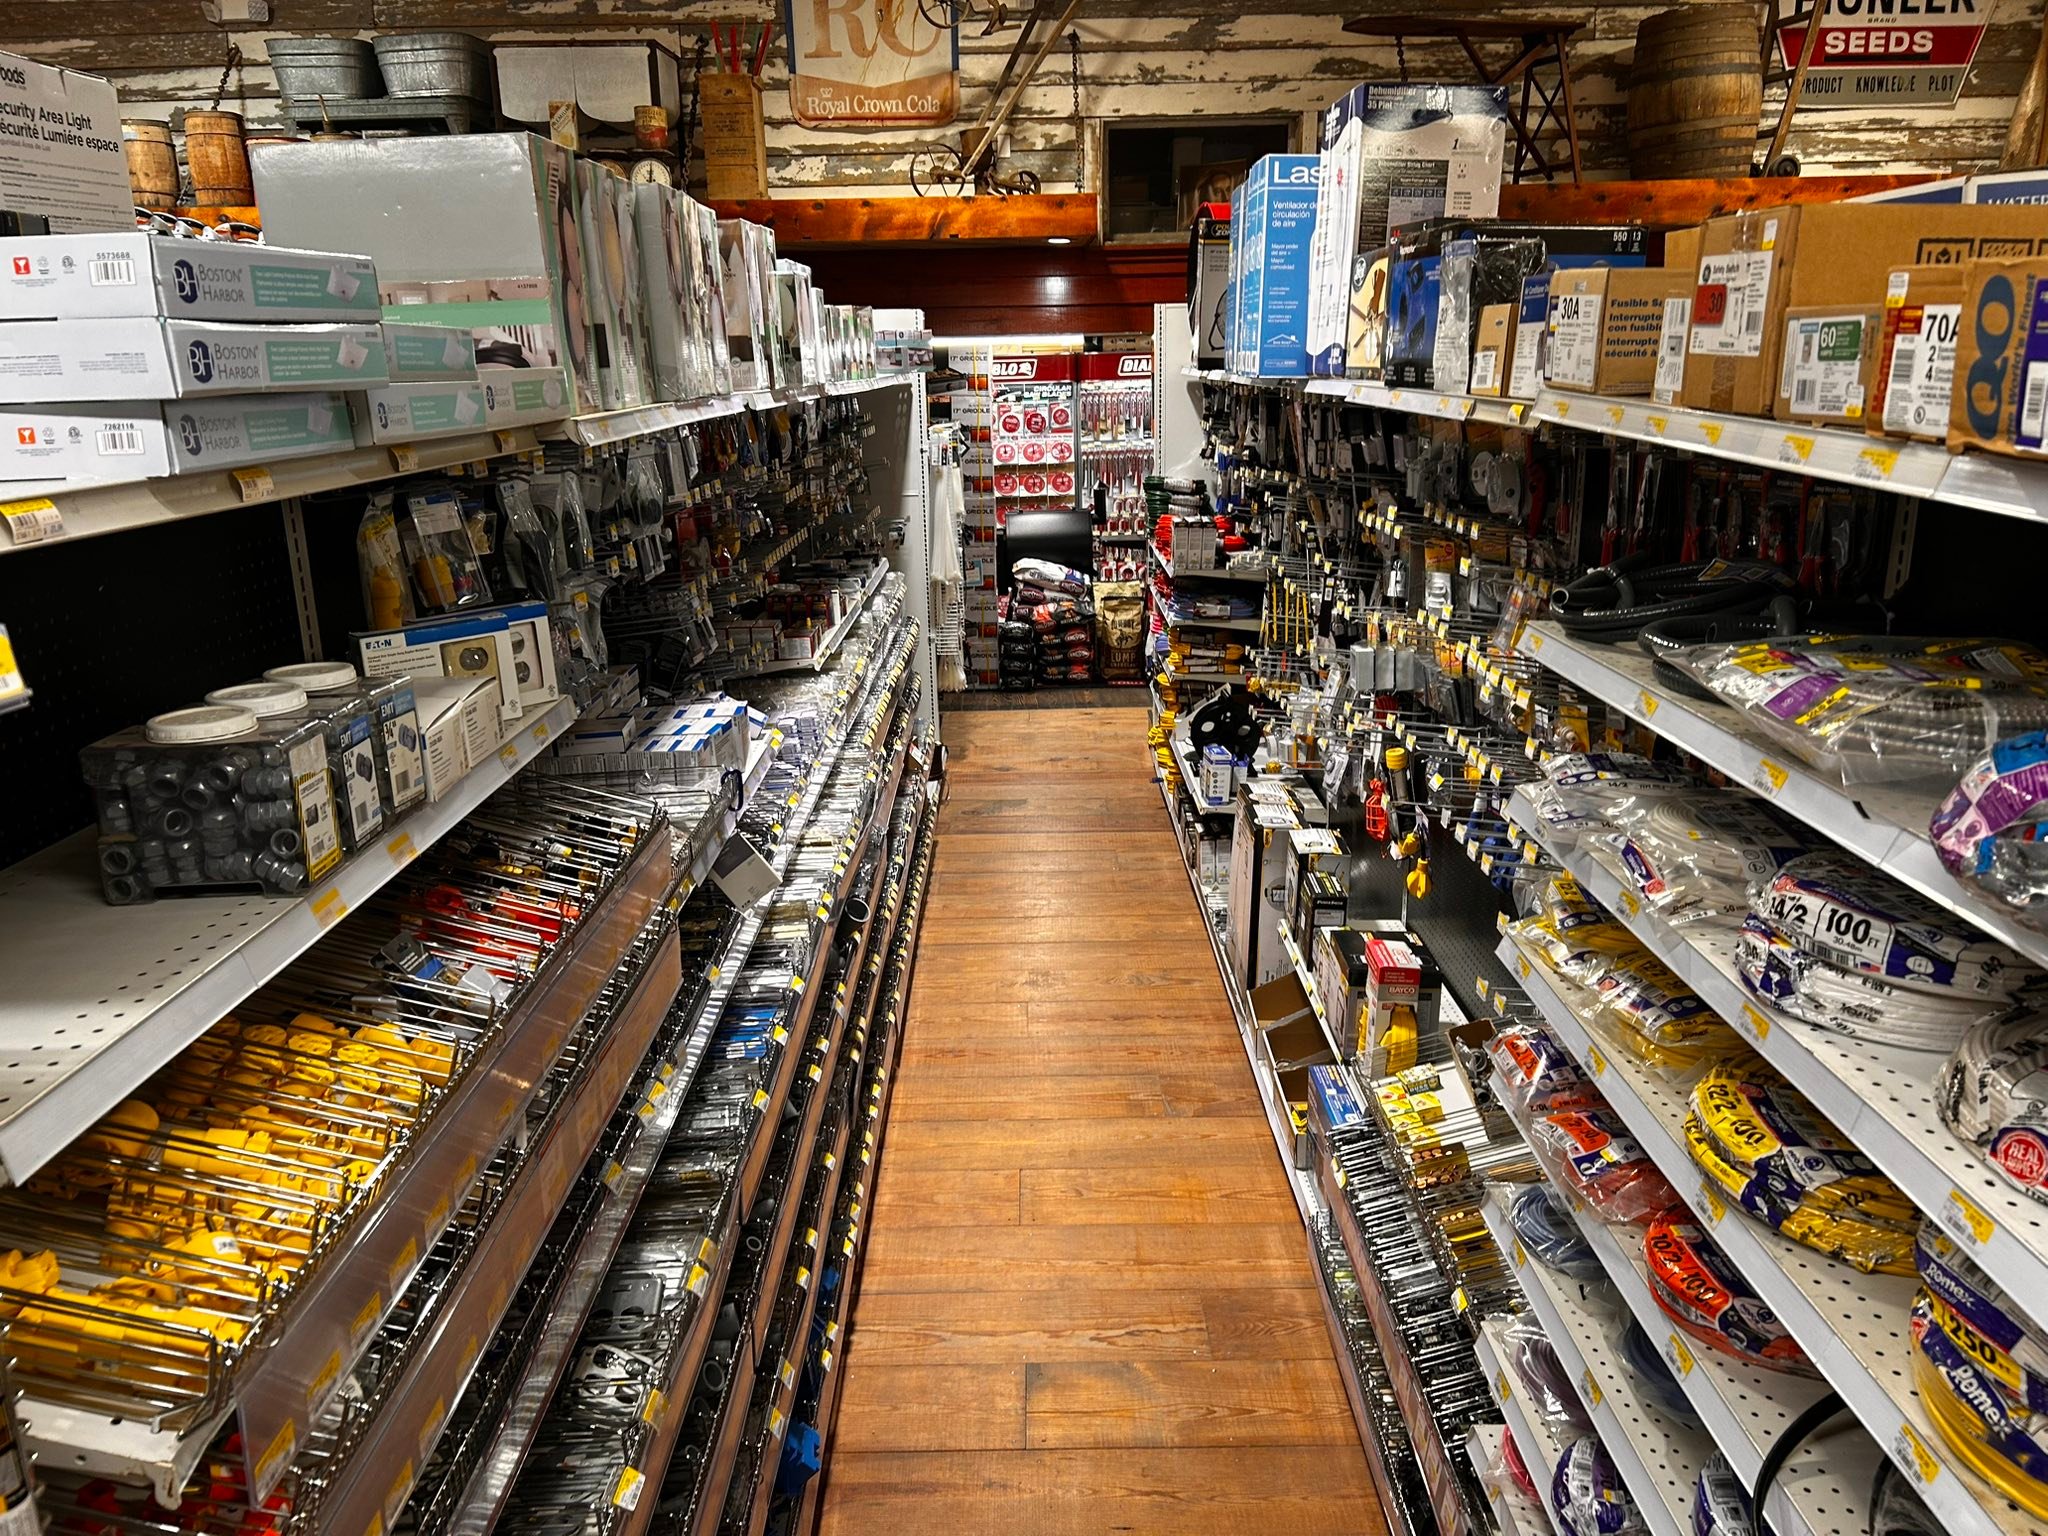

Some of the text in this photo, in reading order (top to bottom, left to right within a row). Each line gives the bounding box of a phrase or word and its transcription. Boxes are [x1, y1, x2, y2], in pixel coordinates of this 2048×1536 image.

[1825, 31, 1934, 54] SEEDS
[1855, 75, 1916, 94] KNOWLEDE
[1928, 75, 1954, 92] PLOT
[806, 95, 941, 120] Royal Crown Cola
[39, 106, 64, 125] Area
[65, 112, 93, 131] Light
[85, 138, 120, 153] espace
[1273, 200, 1308, 209] Ventilador
[1272, 210, 1310, 218] circulación
[198, 264, 242, 282] BOSTON
[203, 286, 245, 303] HARBOR
[1610, 299, 1649, 308] Fusible
[1708, 292, 1723, 314] 30
[1561, 297, 1580, 320] 30A
[1820, 327, 1837, 347] 60
[214, 343, 258, 361] BOSTON
[1604, 349, 1658, 358] sécurité à
[1927, 346, 1936, 363] 2
[218, 365, 260, 380] HARBOR
[1925, 365, 1933, 382] 4
[1111, 652, 1136, 662] LUMP
[380, 702, 395, 717] EMT
[339, 736, 352, 748] EMT
[1825, 908, 1872, 945] 100
[1867, 936, 1880, 949] FT
[1832, 936, 1863, 953] 30.48m
[2007, 1142, 2040, 1164] REAL
[2004, 1155, 2041, 1179] ROMEX
[1650, 1233, 1683, 1263] 10/2
[1680, 1272, 1718, 1303] 100
[1927, 1262, 1977, 1310] Romex
[1949, 1315, 1998, 1366] 250
[1950, 1363, 2014, 1441] Romex
